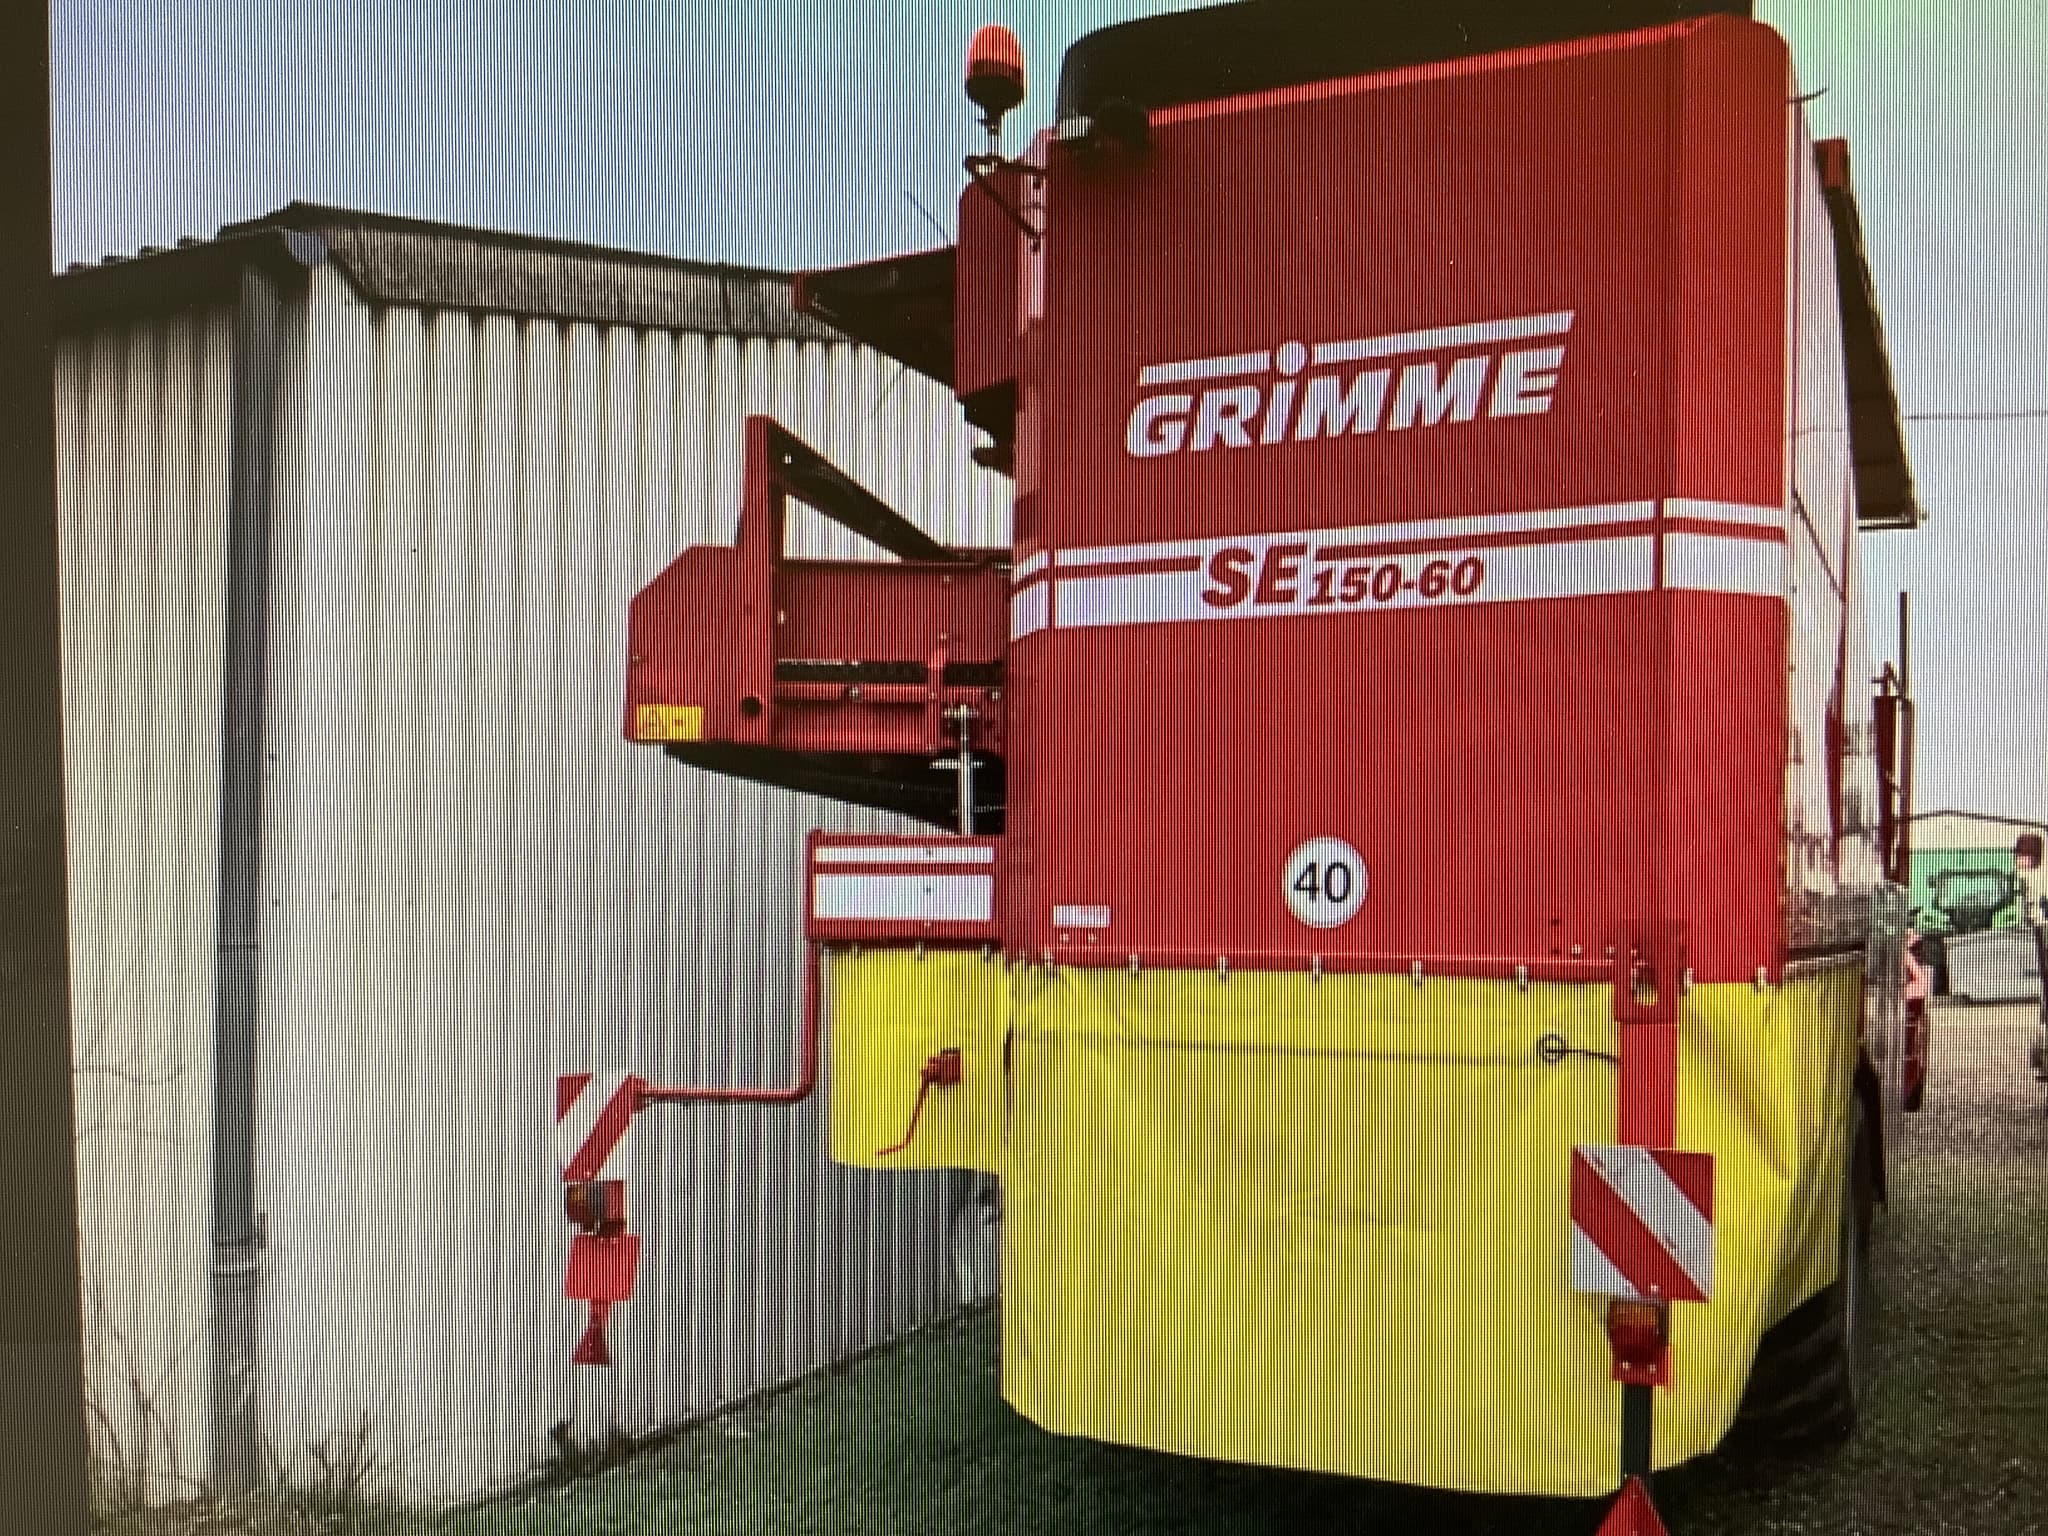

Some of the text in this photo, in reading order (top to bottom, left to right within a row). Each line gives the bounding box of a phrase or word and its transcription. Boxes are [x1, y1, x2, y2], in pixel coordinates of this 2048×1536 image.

[1201, 545, 1485, 607] SE 150-60
[1293, 861, 1352, 903] 40
